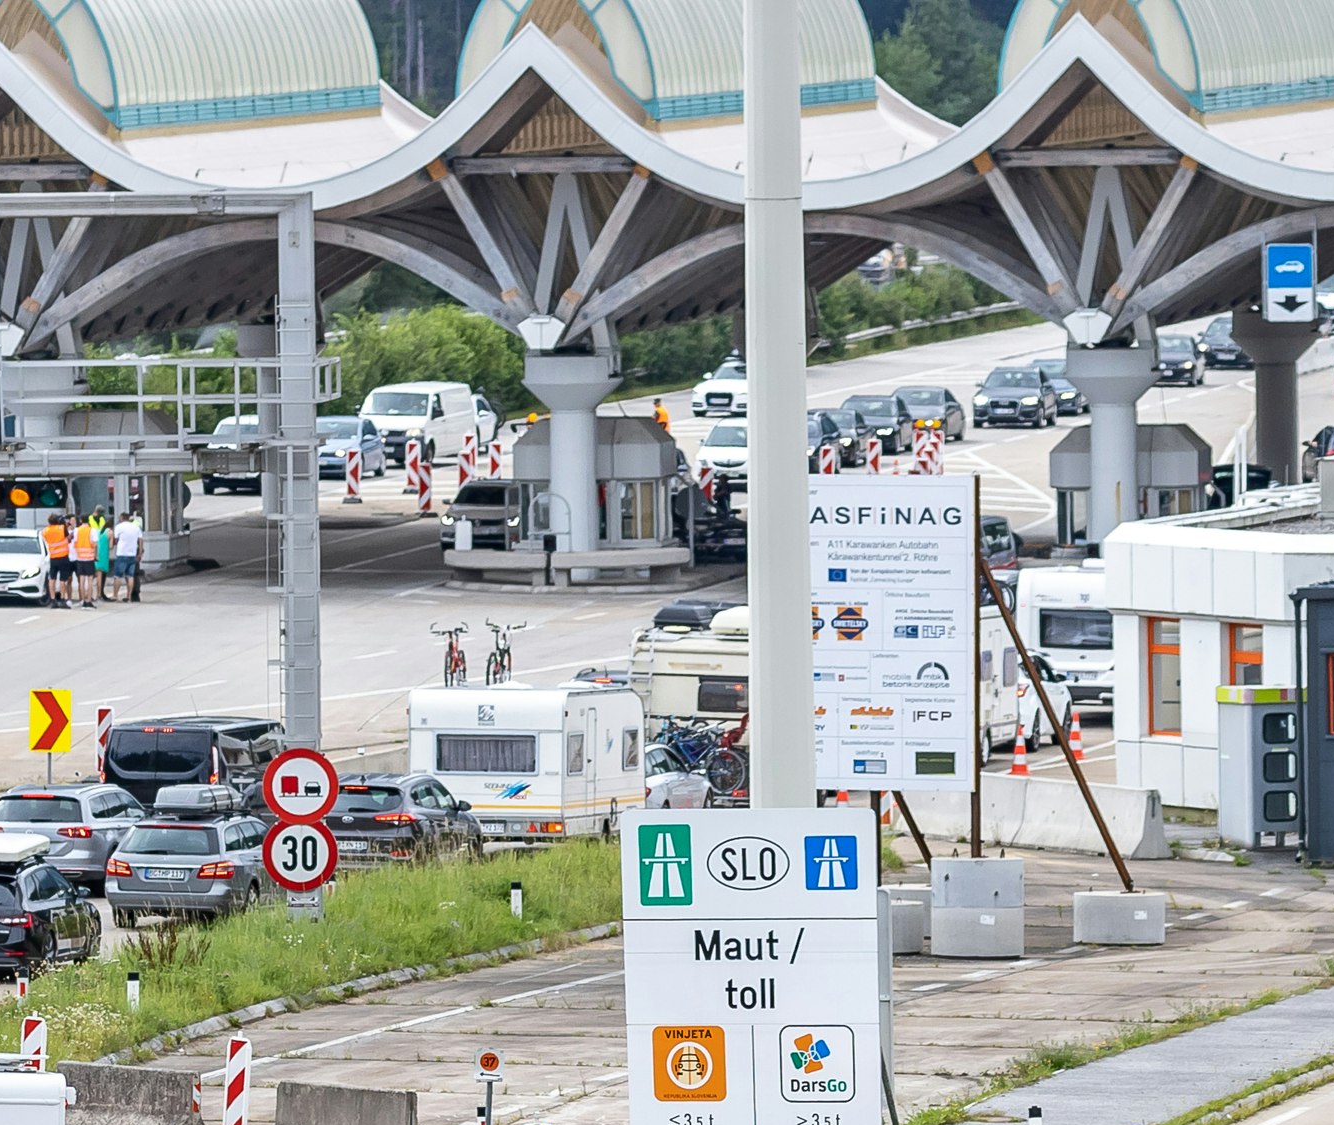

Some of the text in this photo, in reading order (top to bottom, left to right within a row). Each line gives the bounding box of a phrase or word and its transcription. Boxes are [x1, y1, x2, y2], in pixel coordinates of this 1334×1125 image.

[827, 540, 844, 549] A11
[846, 540, 897, 549] Karawanken
[899, 540, 939, 549] Autobahn
[882, 681, 950, 689] betonkonzepte
[282, 835, 318, 871] 30
[721, 847, 776, 881] SLO
[694, 928, 805, 964] Maut /
[725, 978, 775, 1010] toll
[665, 1029, 712, 1039] VINJETA
[483, 1057, 496, 1067] 37
[790, 1079, 847, 1093] DarsGo
